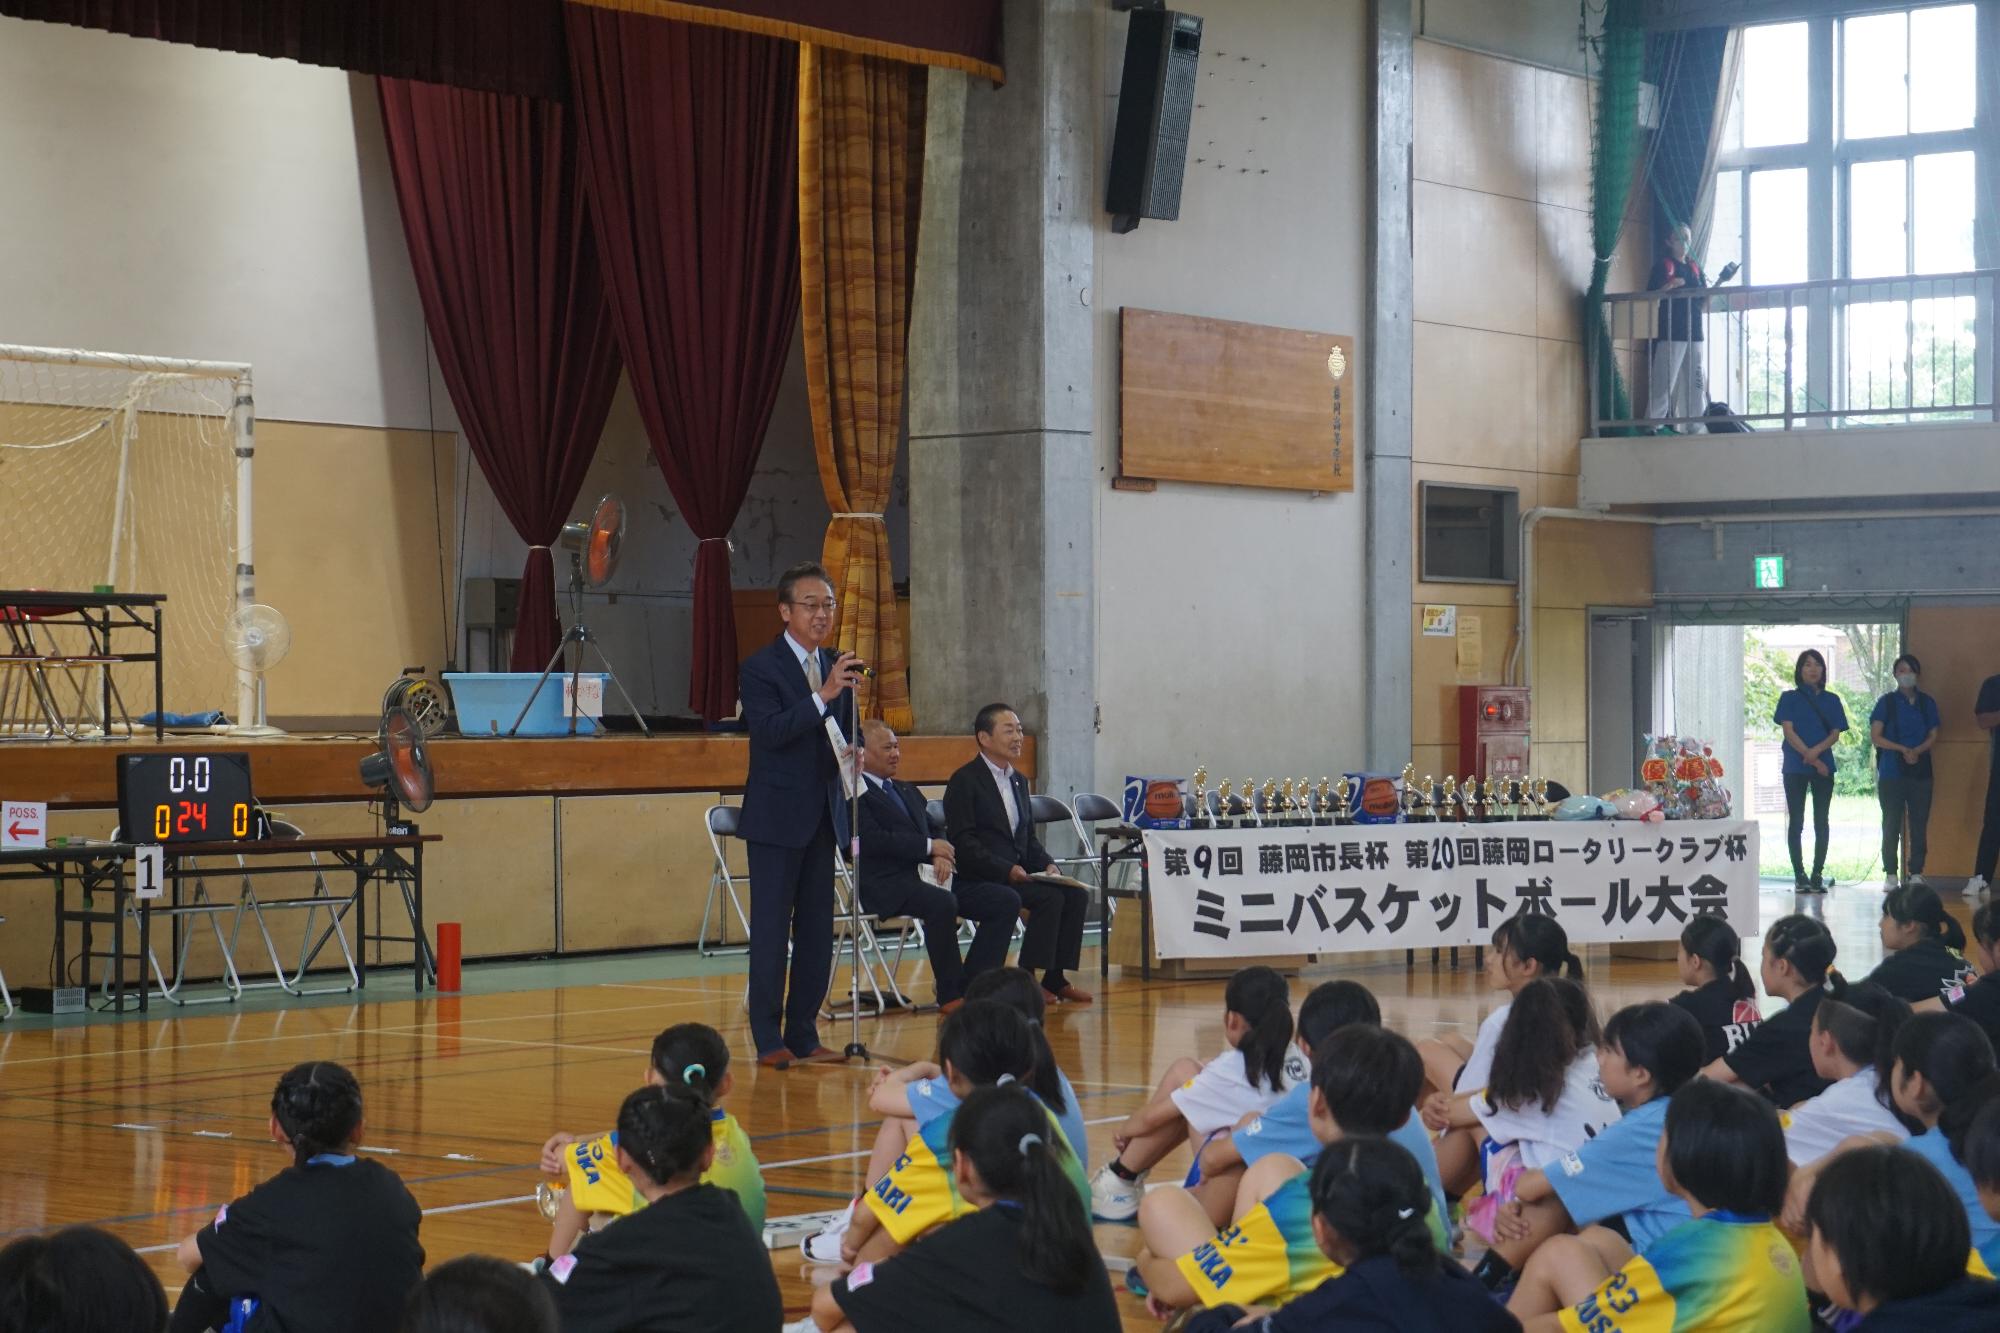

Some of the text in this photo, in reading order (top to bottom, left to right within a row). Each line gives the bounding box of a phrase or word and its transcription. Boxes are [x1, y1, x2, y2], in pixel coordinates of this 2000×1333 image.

[170, 757, 210, 793] 0.0
[9, 806, 39, 819] POSS.
[155, 804, 171, 839] 0
[177, 801, 207, 833] 24
[233, 803, 248, 837] 0
[139, 853, 158, 890] 1
[1163, 833, 1748, 880] 第9回 藤岡市長杯 第20回藤岡ロータリークラブ杯
[1192, 873, 1729, 941] ミニバスケットボール大会
